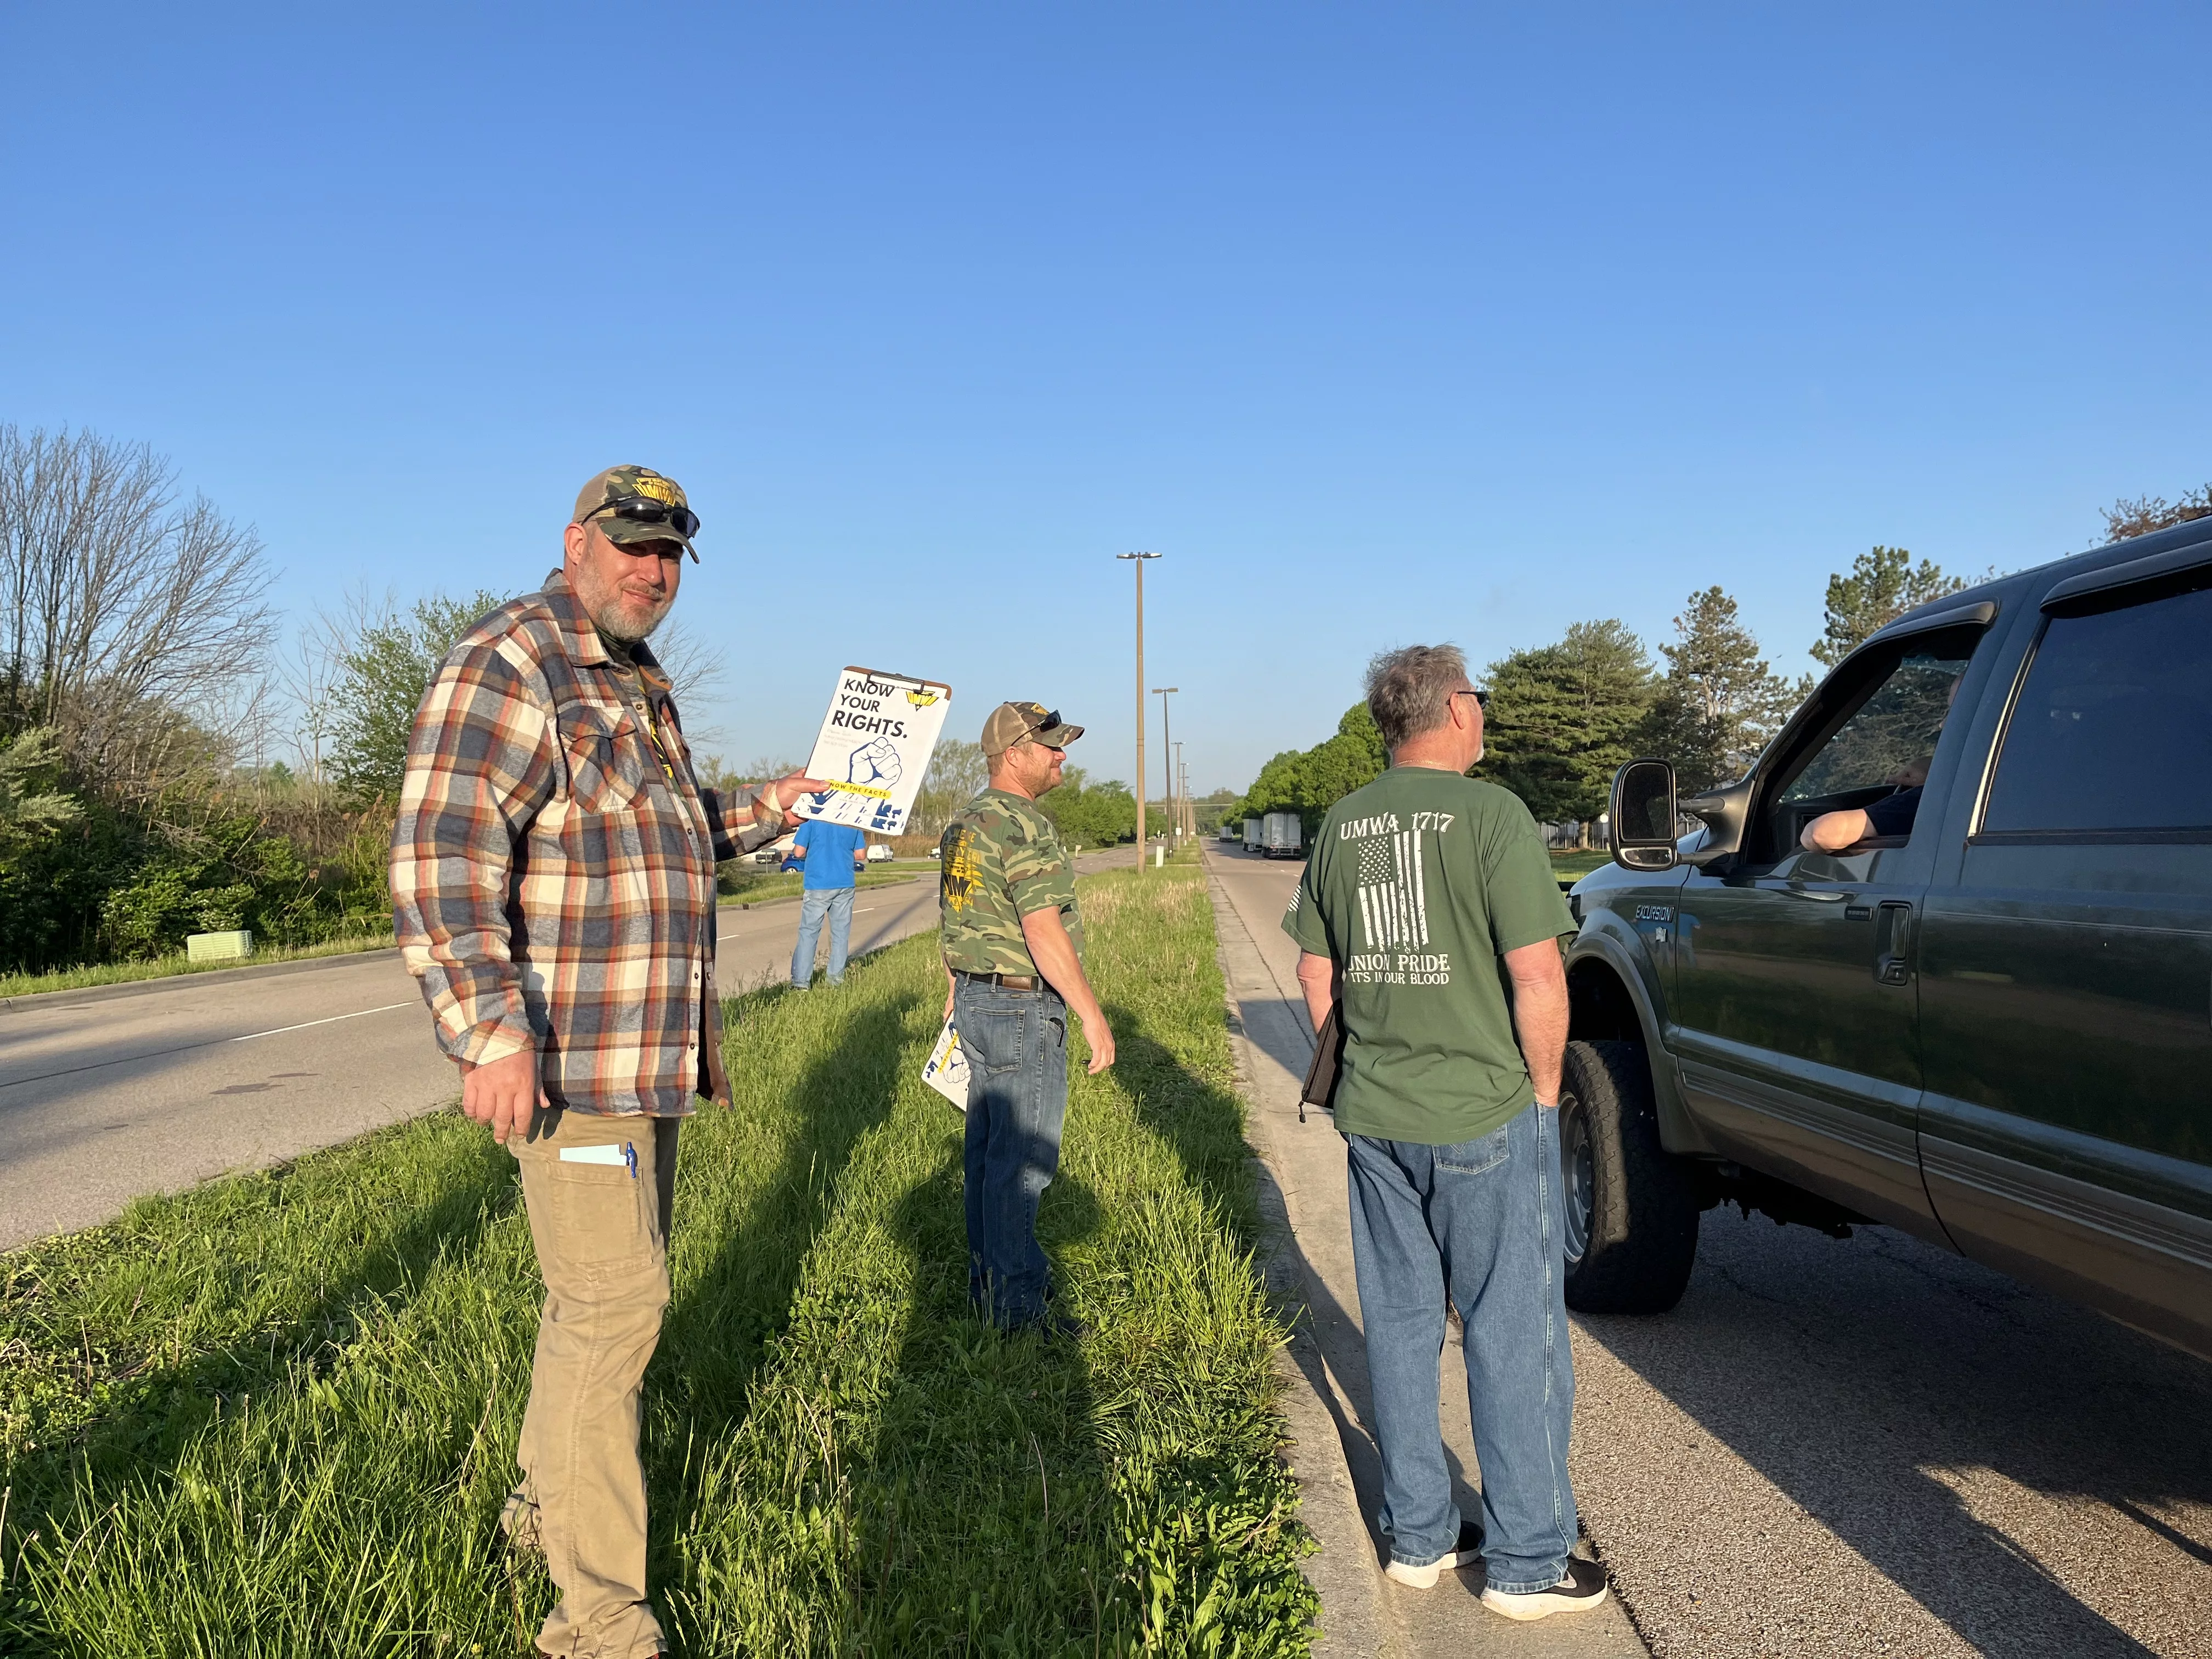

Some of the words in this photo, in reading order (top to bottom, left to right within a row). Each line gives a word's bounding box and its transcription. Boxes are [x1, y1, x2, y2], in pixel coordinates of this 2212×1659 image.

[844, 678, 895, 697] KNOW
[840, 693, 881, 713] YOUR
[831, 709, 907, 738] RIGHTS.
[864, 788, 887, 797] FACTS
[1340, 811, 1401, 840] UMWA
[1411, 811, 1455, 833] 1717
[1635, 904, 1672, 922] EXCURSION
[1348, 953, 1391, 972] UNION
[1397, 953, 1451, 973] PRIDE
[1350, 972, 1372, 983] IT'S
[1374, 971, 1384, 983] IN
[1384, 972, 1407, 985] OUR
[1410, 973, 1450, 985] BLOOD
